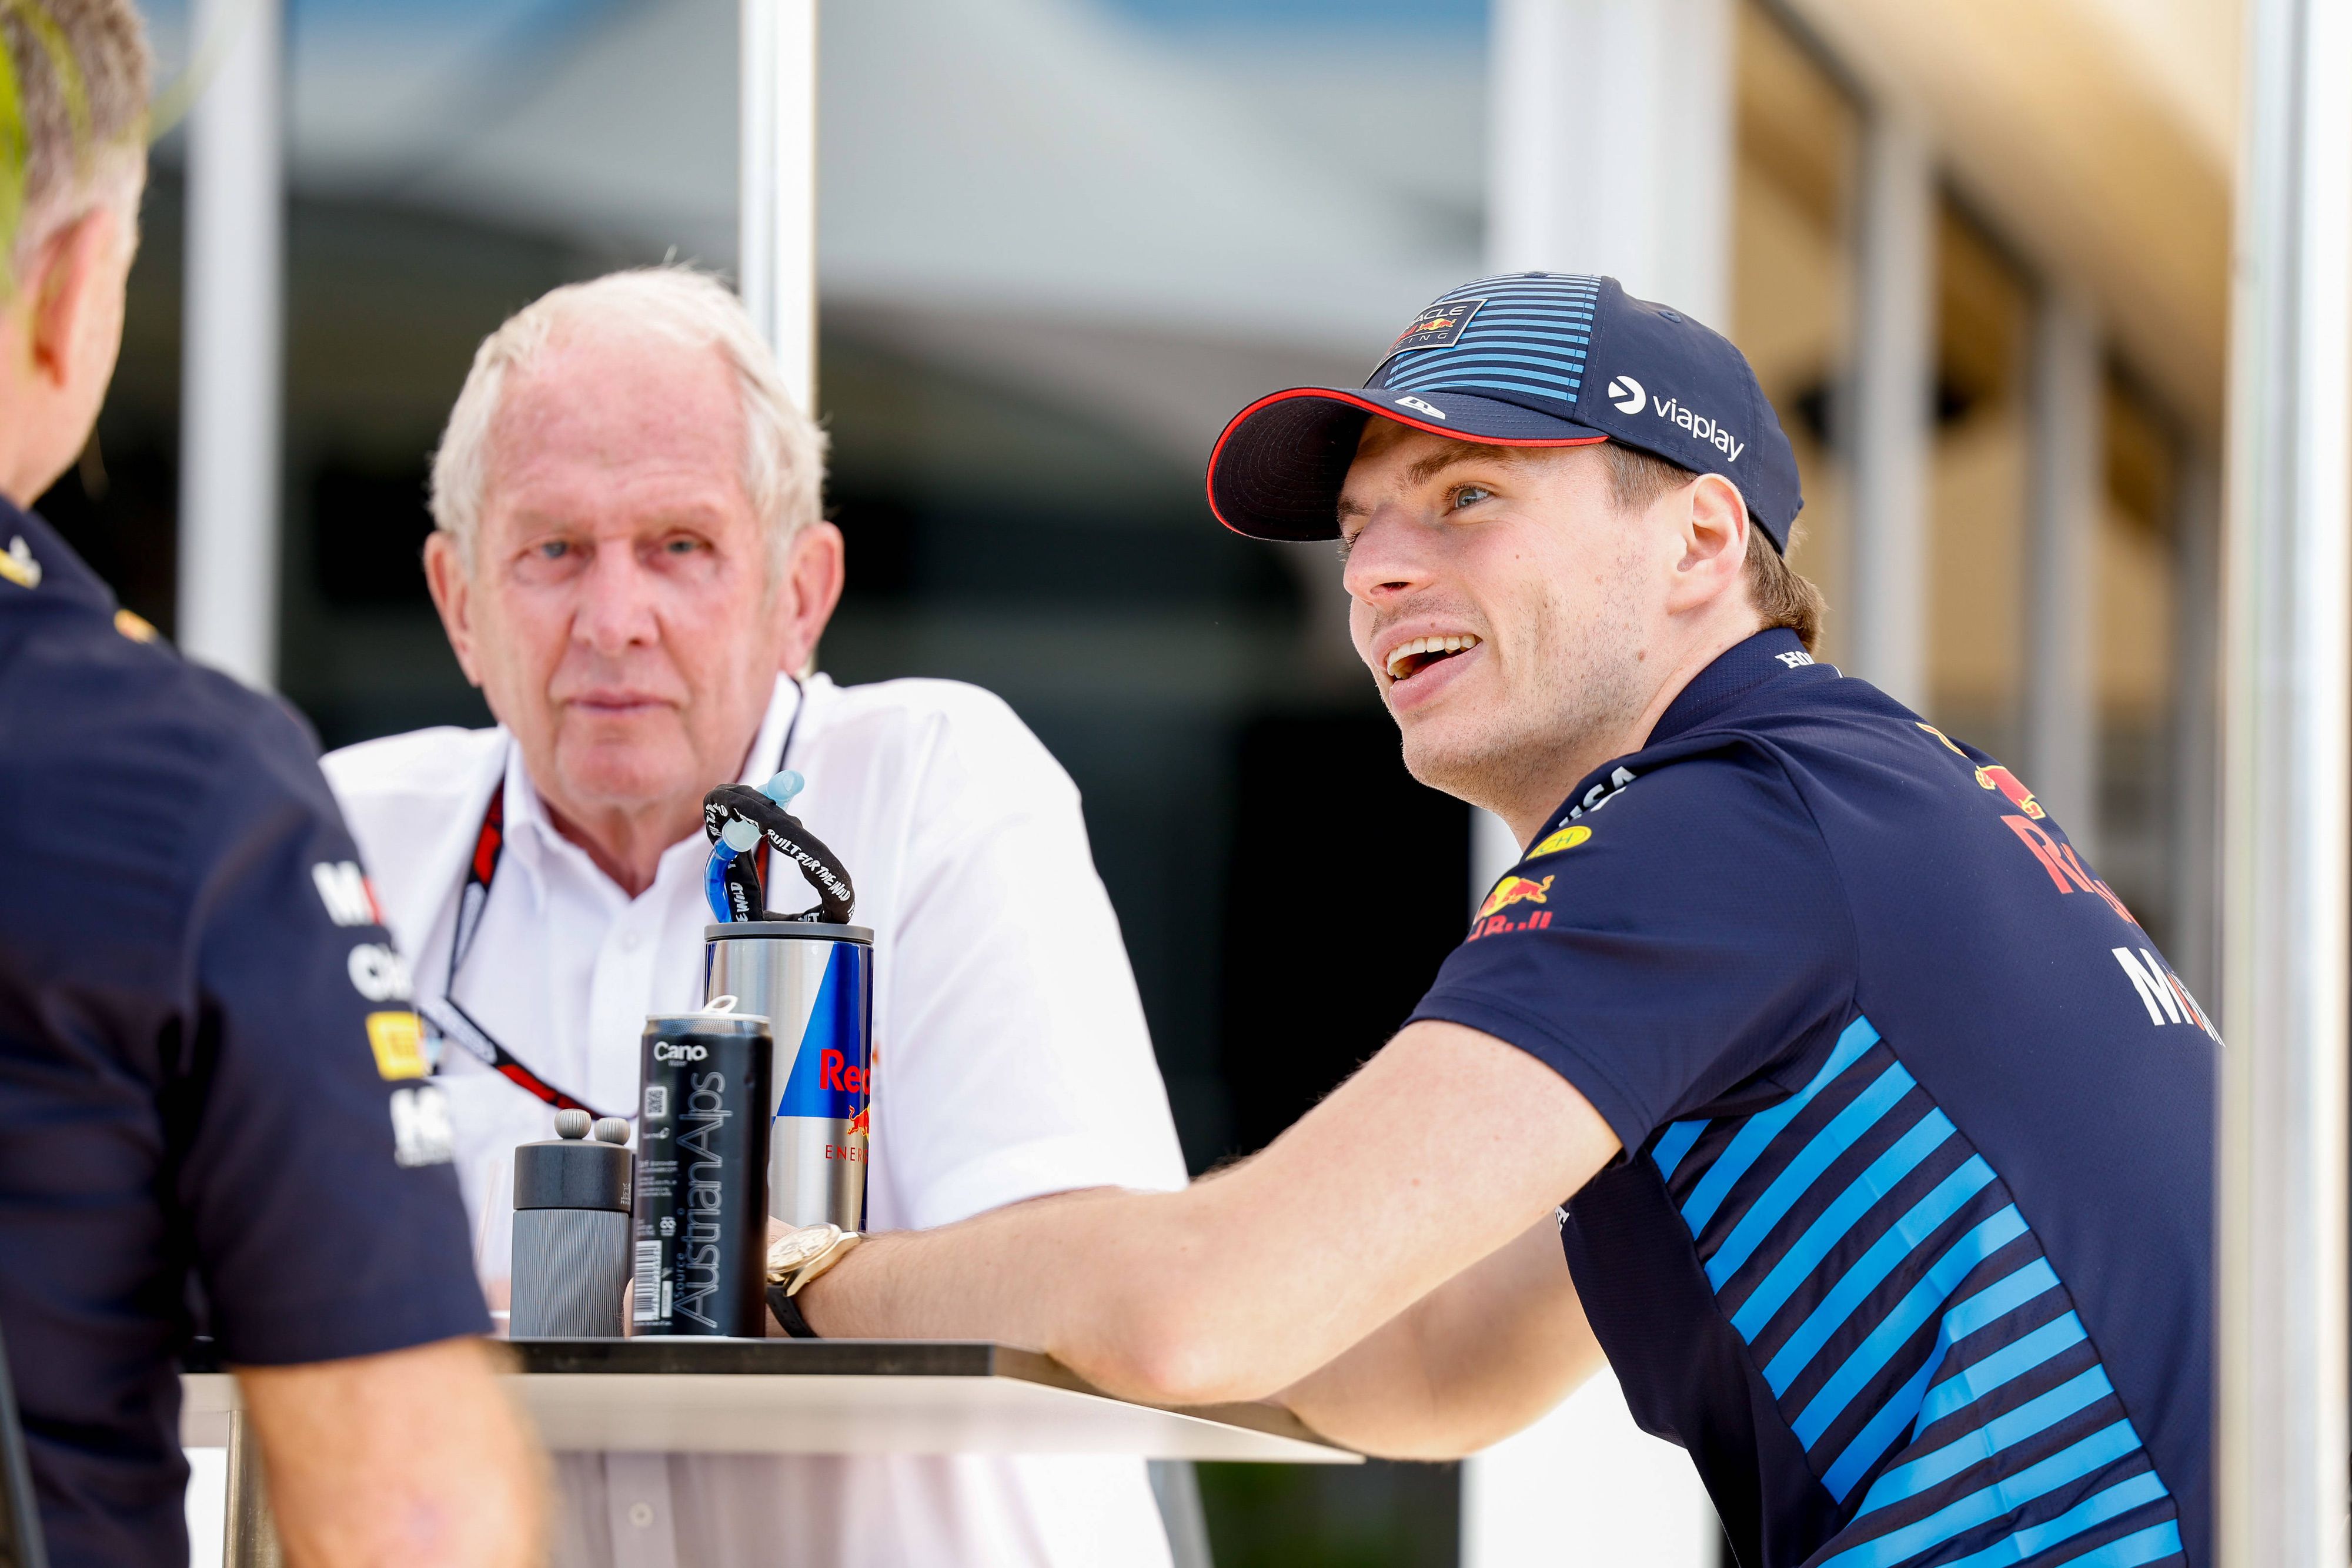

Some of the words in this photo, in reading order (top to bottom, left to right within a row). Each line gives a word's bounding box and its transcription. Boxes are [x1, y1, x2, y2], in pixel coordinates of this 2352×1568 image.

[1411, 306, 1468, 323] ACLE
[1653, 395, 1745, 462] viaplay
[796, 852, 821, 871] FOR
[816, 866, 836, 886] THE
[828, 881, 851, 901] WILD
[676, 1071, 733, 1162] Alps
[825, 1144, 868, 1164] ENERG
[673, 1161, 723, 1329] Austrian
